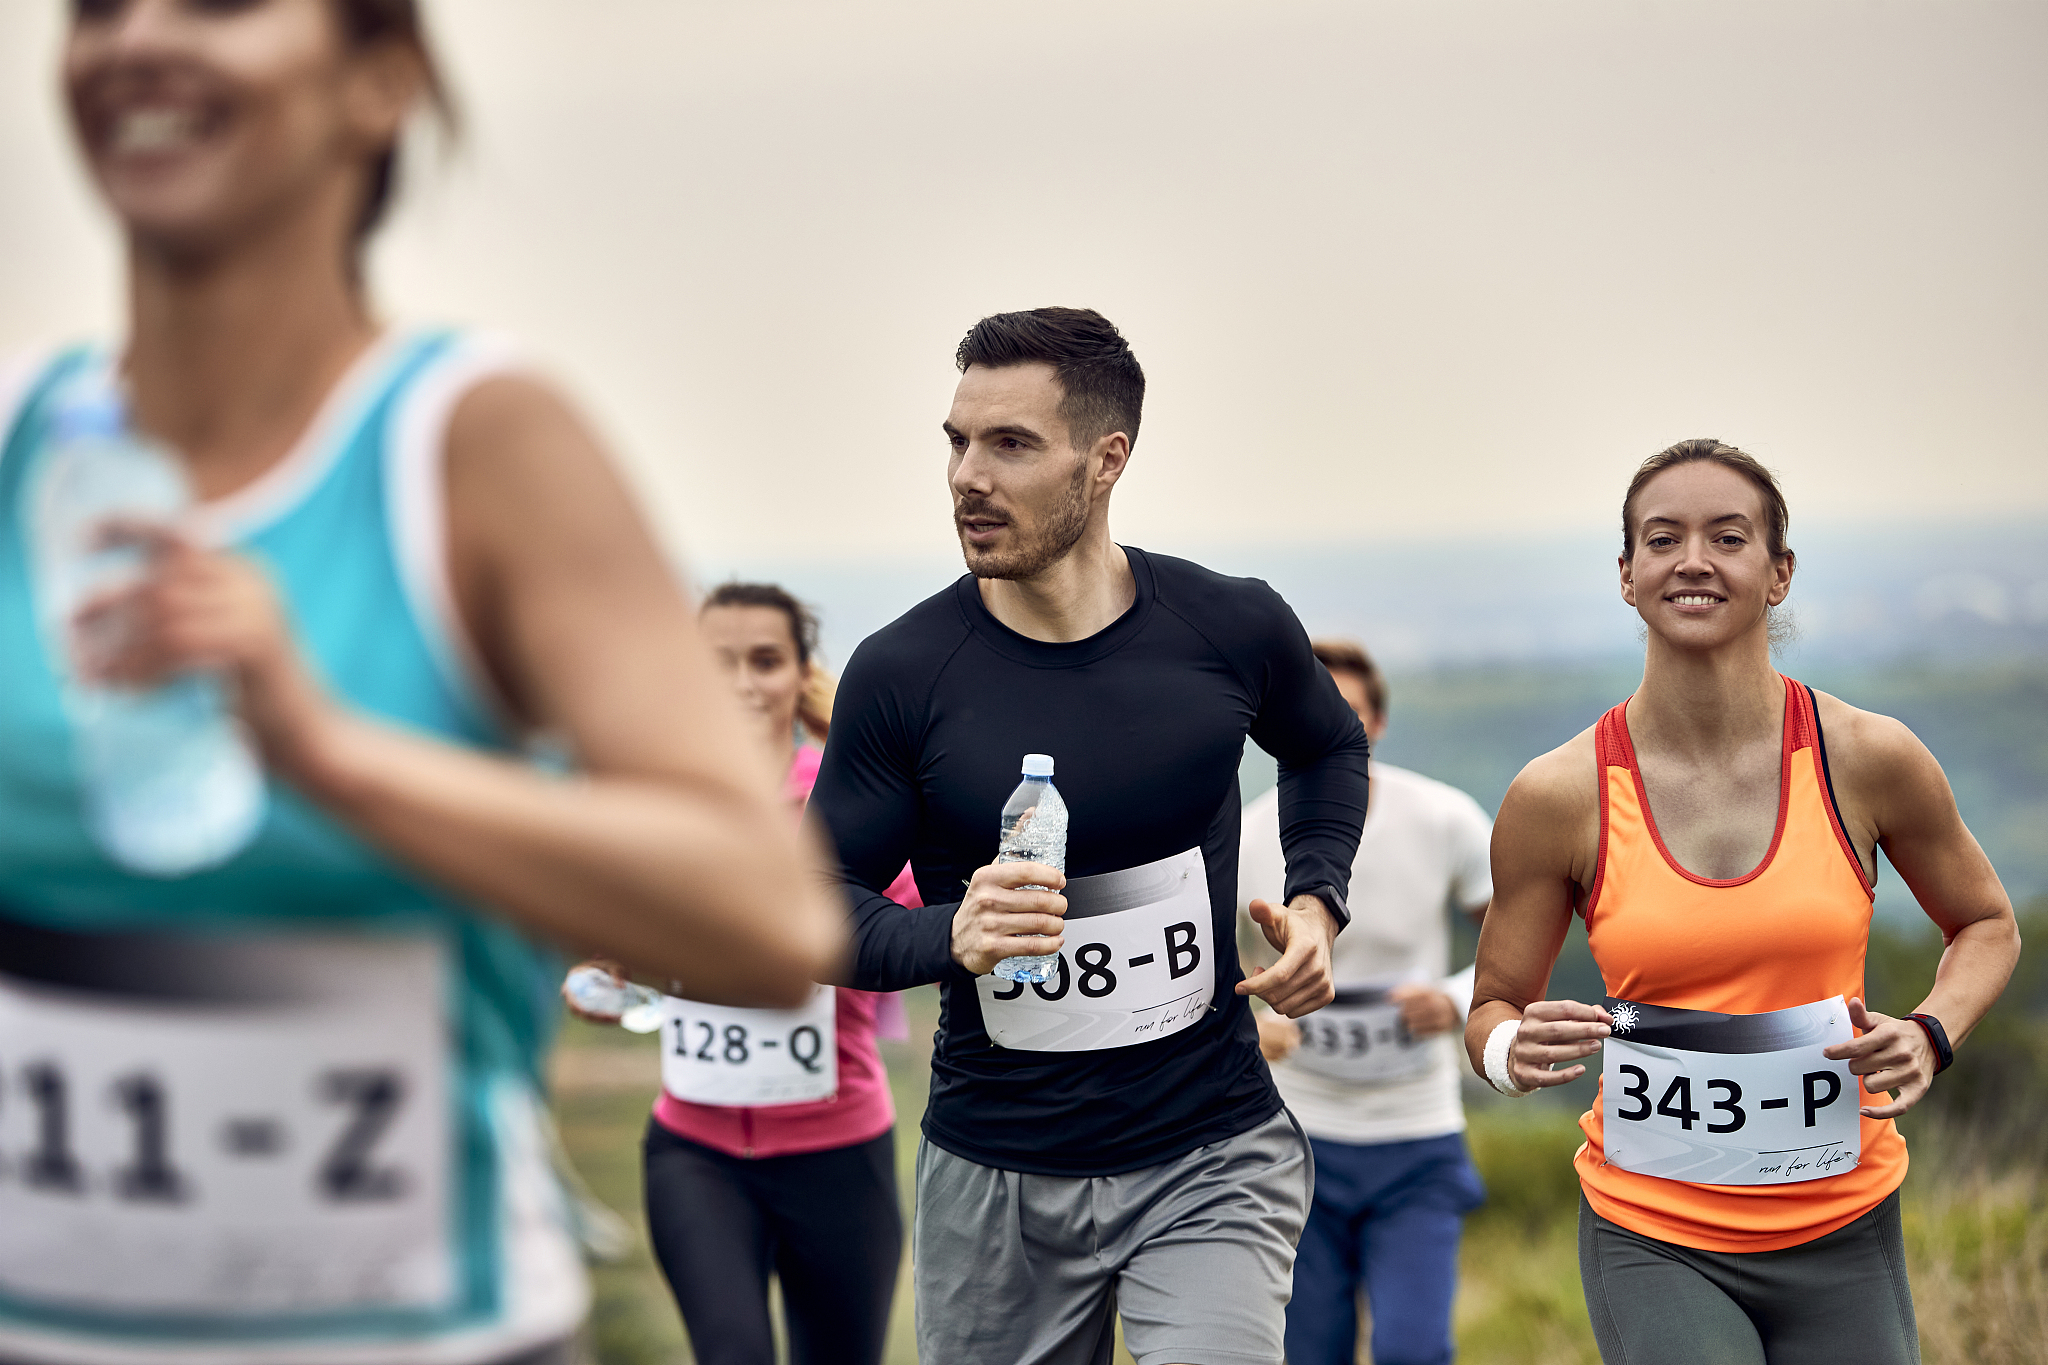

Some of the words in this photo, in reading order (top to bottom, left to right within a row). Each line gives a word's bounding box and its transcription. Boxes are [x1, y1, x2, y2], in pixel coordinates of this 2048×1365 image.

[671, 1018, 823, 1073] 128-Q
[1135, 1021, 1155, 1032] run
[1160, 1010, 1179, 1031] for
[1618, 1064, 1842, 1133] 343-P
[0, 1060, 412, 1210] 11-Z
[1759, 1165, 1781, 1174] run
[1786, 1157, 1810, 1176] for
[1816, 1148, 1844, 1171] life
